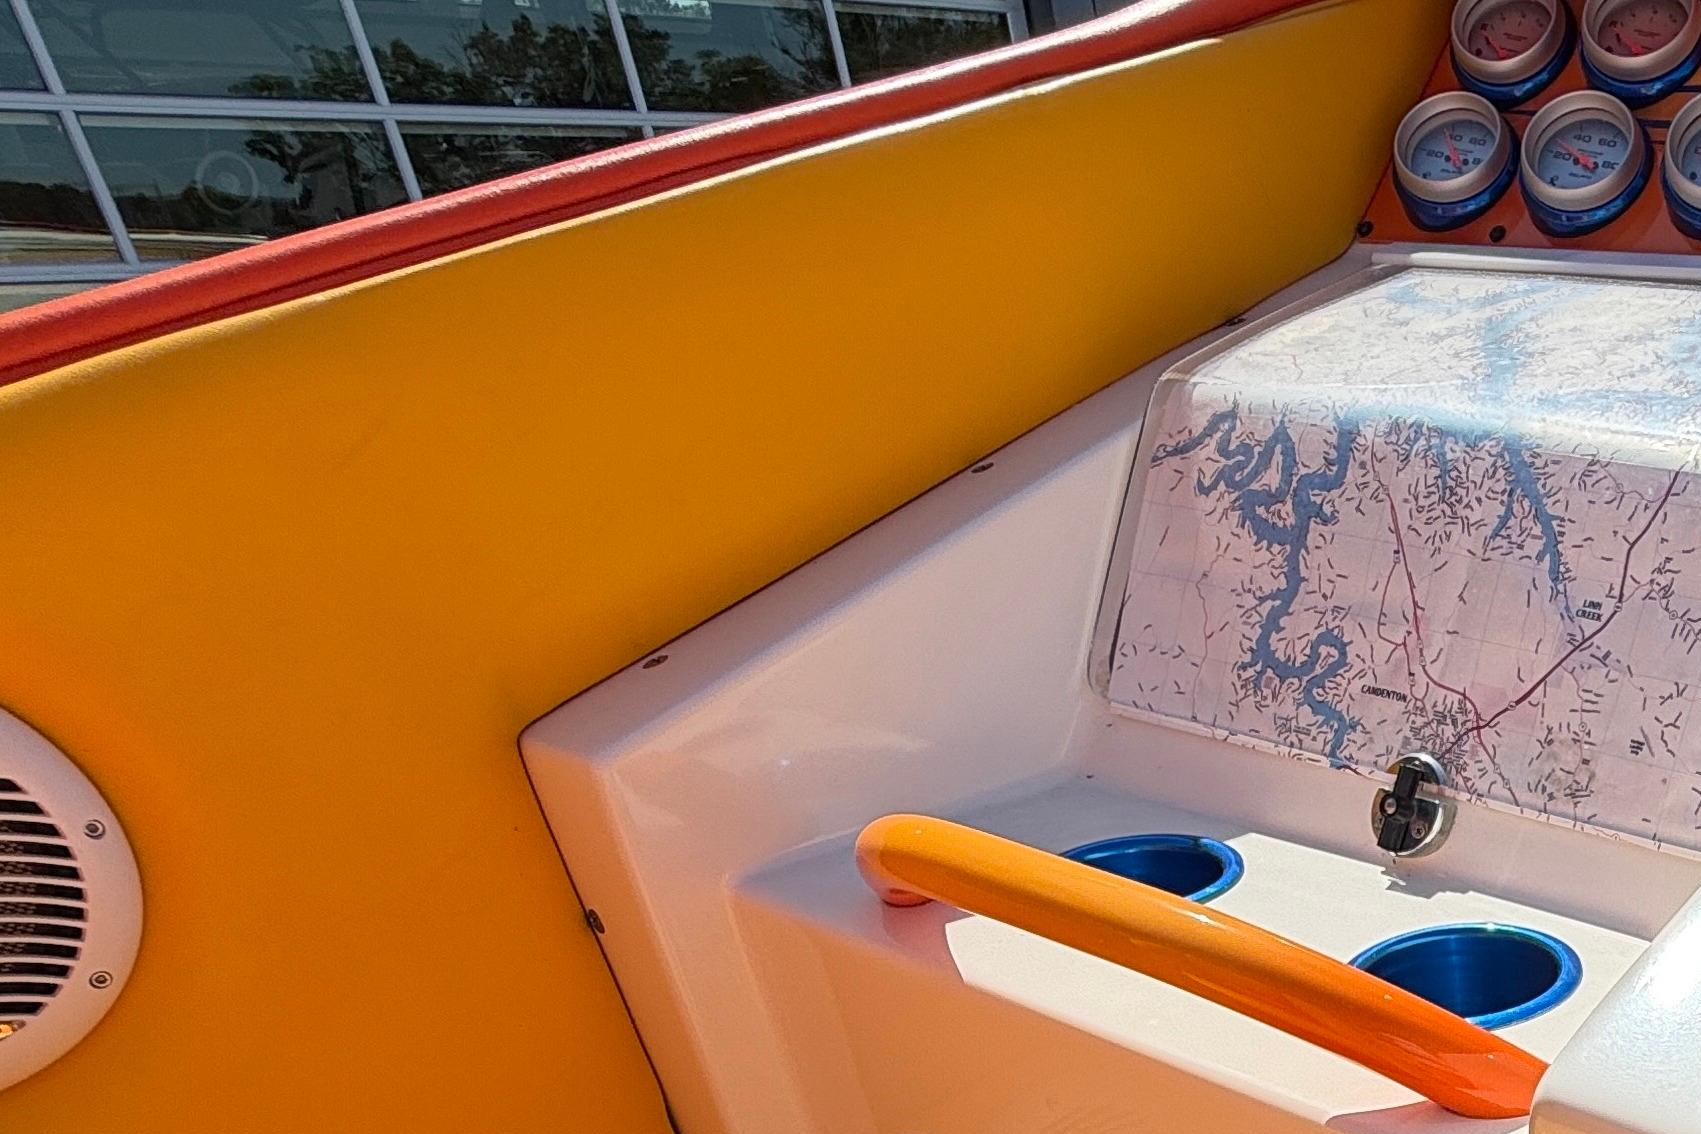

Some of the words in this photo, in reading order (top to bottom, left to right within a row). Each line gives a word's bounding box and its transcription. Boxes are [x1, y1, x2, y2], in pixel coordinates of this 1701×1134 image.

[1573, 133, 1593, 144] 40
[1575, 608, 1604, 623] CREEK
[1360, 683, 1408, 704] CAMDENTON
